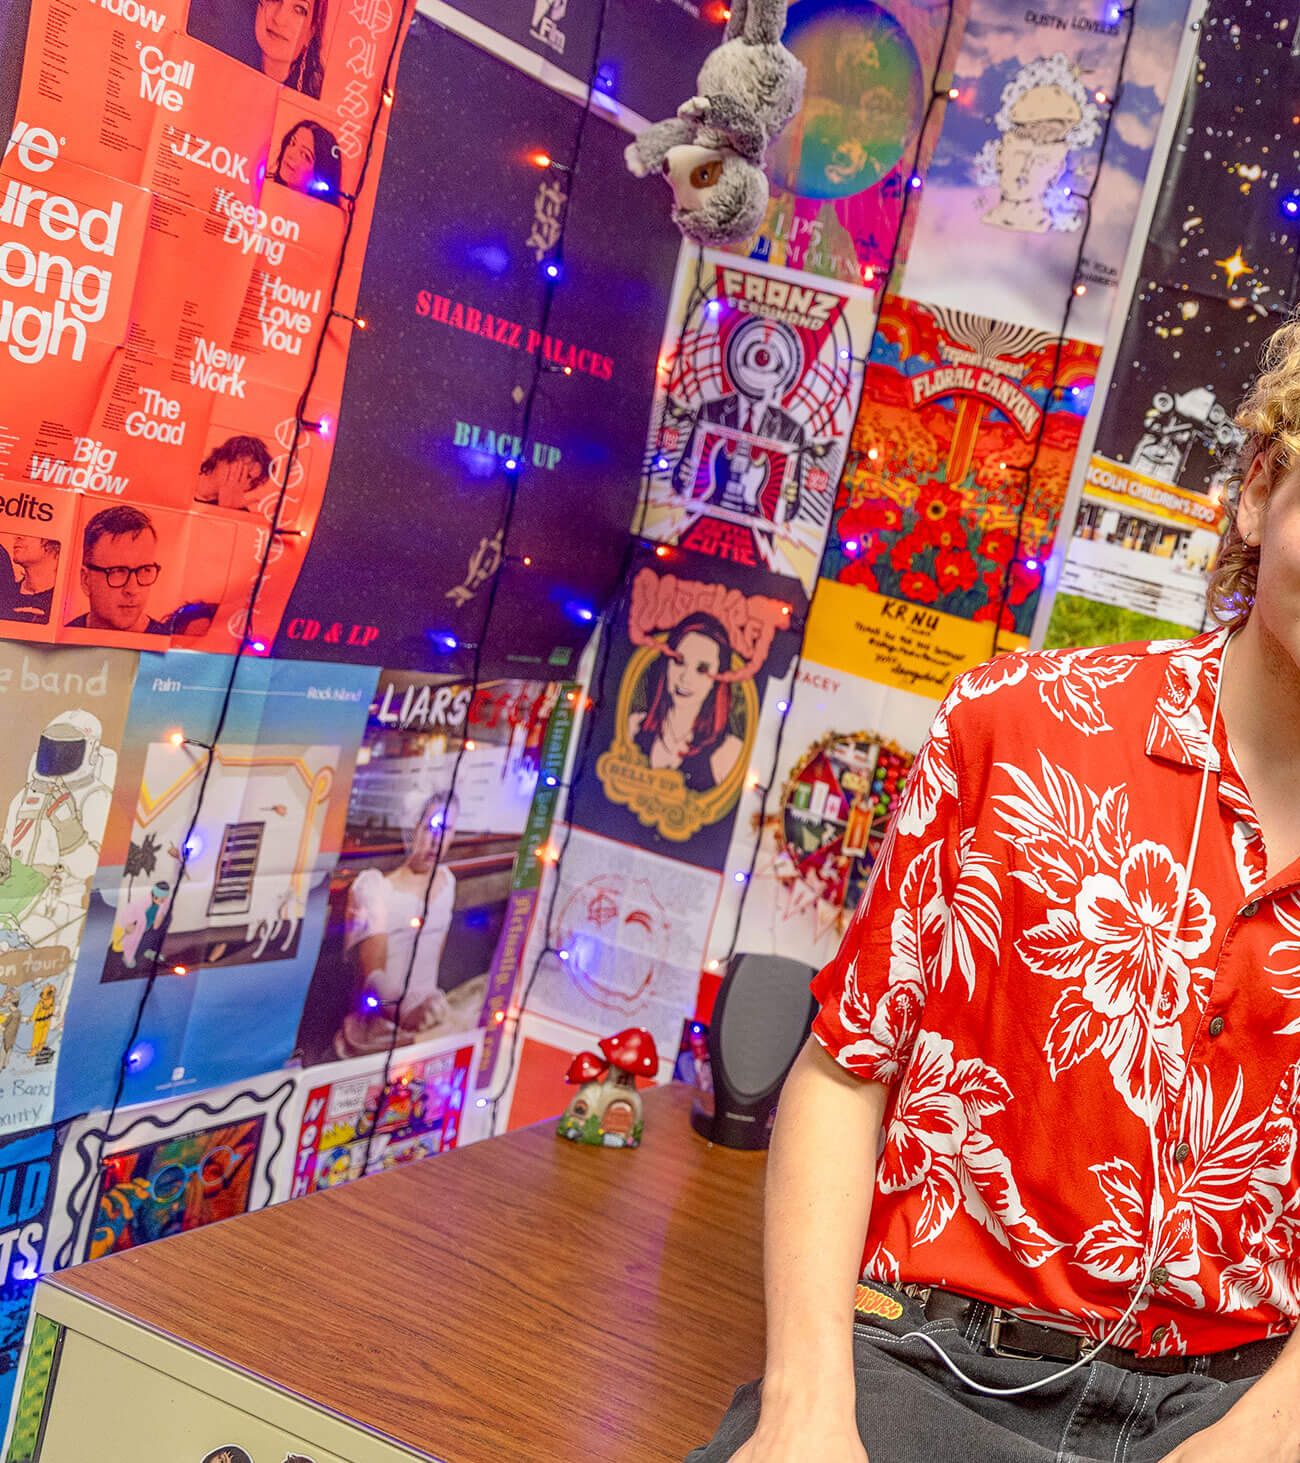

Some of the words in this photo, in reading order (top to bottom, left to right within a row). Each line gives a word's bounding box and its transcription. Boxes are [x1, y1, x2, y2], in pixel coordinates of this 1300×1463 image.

[90, 0, 166, 32] dow
[139, 46, 195, 90] Call
[140, 71, 184, 112] Me
[171, 133, 250, 184] J.Z.O.K.
[215, 187, 268, 232] Keep
[271, 216, 300, 242] on
[223, 218, 285, 266] Dying
[261, 273, 312, 309] How
[312, 289, 321, 313] I
[722, 271, 840, 319] FRANZ
[258, 296, 312, 334] Love
[415, 289, 521, 349] SHABAZZ
[526, 329, 614, 380] PALACES
[195, 338, 246, 374] New
[262, 321, 302, 356] You
[190, 359, 248, 399] Work
[140, 387, 181, 420] The
[912, 366, 976, 404] FLORAL
[976, 370, 1040, 435] CANYON
[125, 411, 186, 446] Goad
[453, 421, 523, 464] BLACK
[532, 442, 562, 470] UP
[30, 455, 129, 495] Window
[73, 437, 117, 474] Big
[1189, 501, 1216, 523] ZOO
[287, 618, 320, 642] CD
[324, 621, 343, 643] &
[347, 624, 380, 647] LP
[20, 656, 109, 697] band
[152, 676, 181, 692] Palm
[377, 682, 471, 727] LIARS
[0, 1160, 51, 1228] LD
